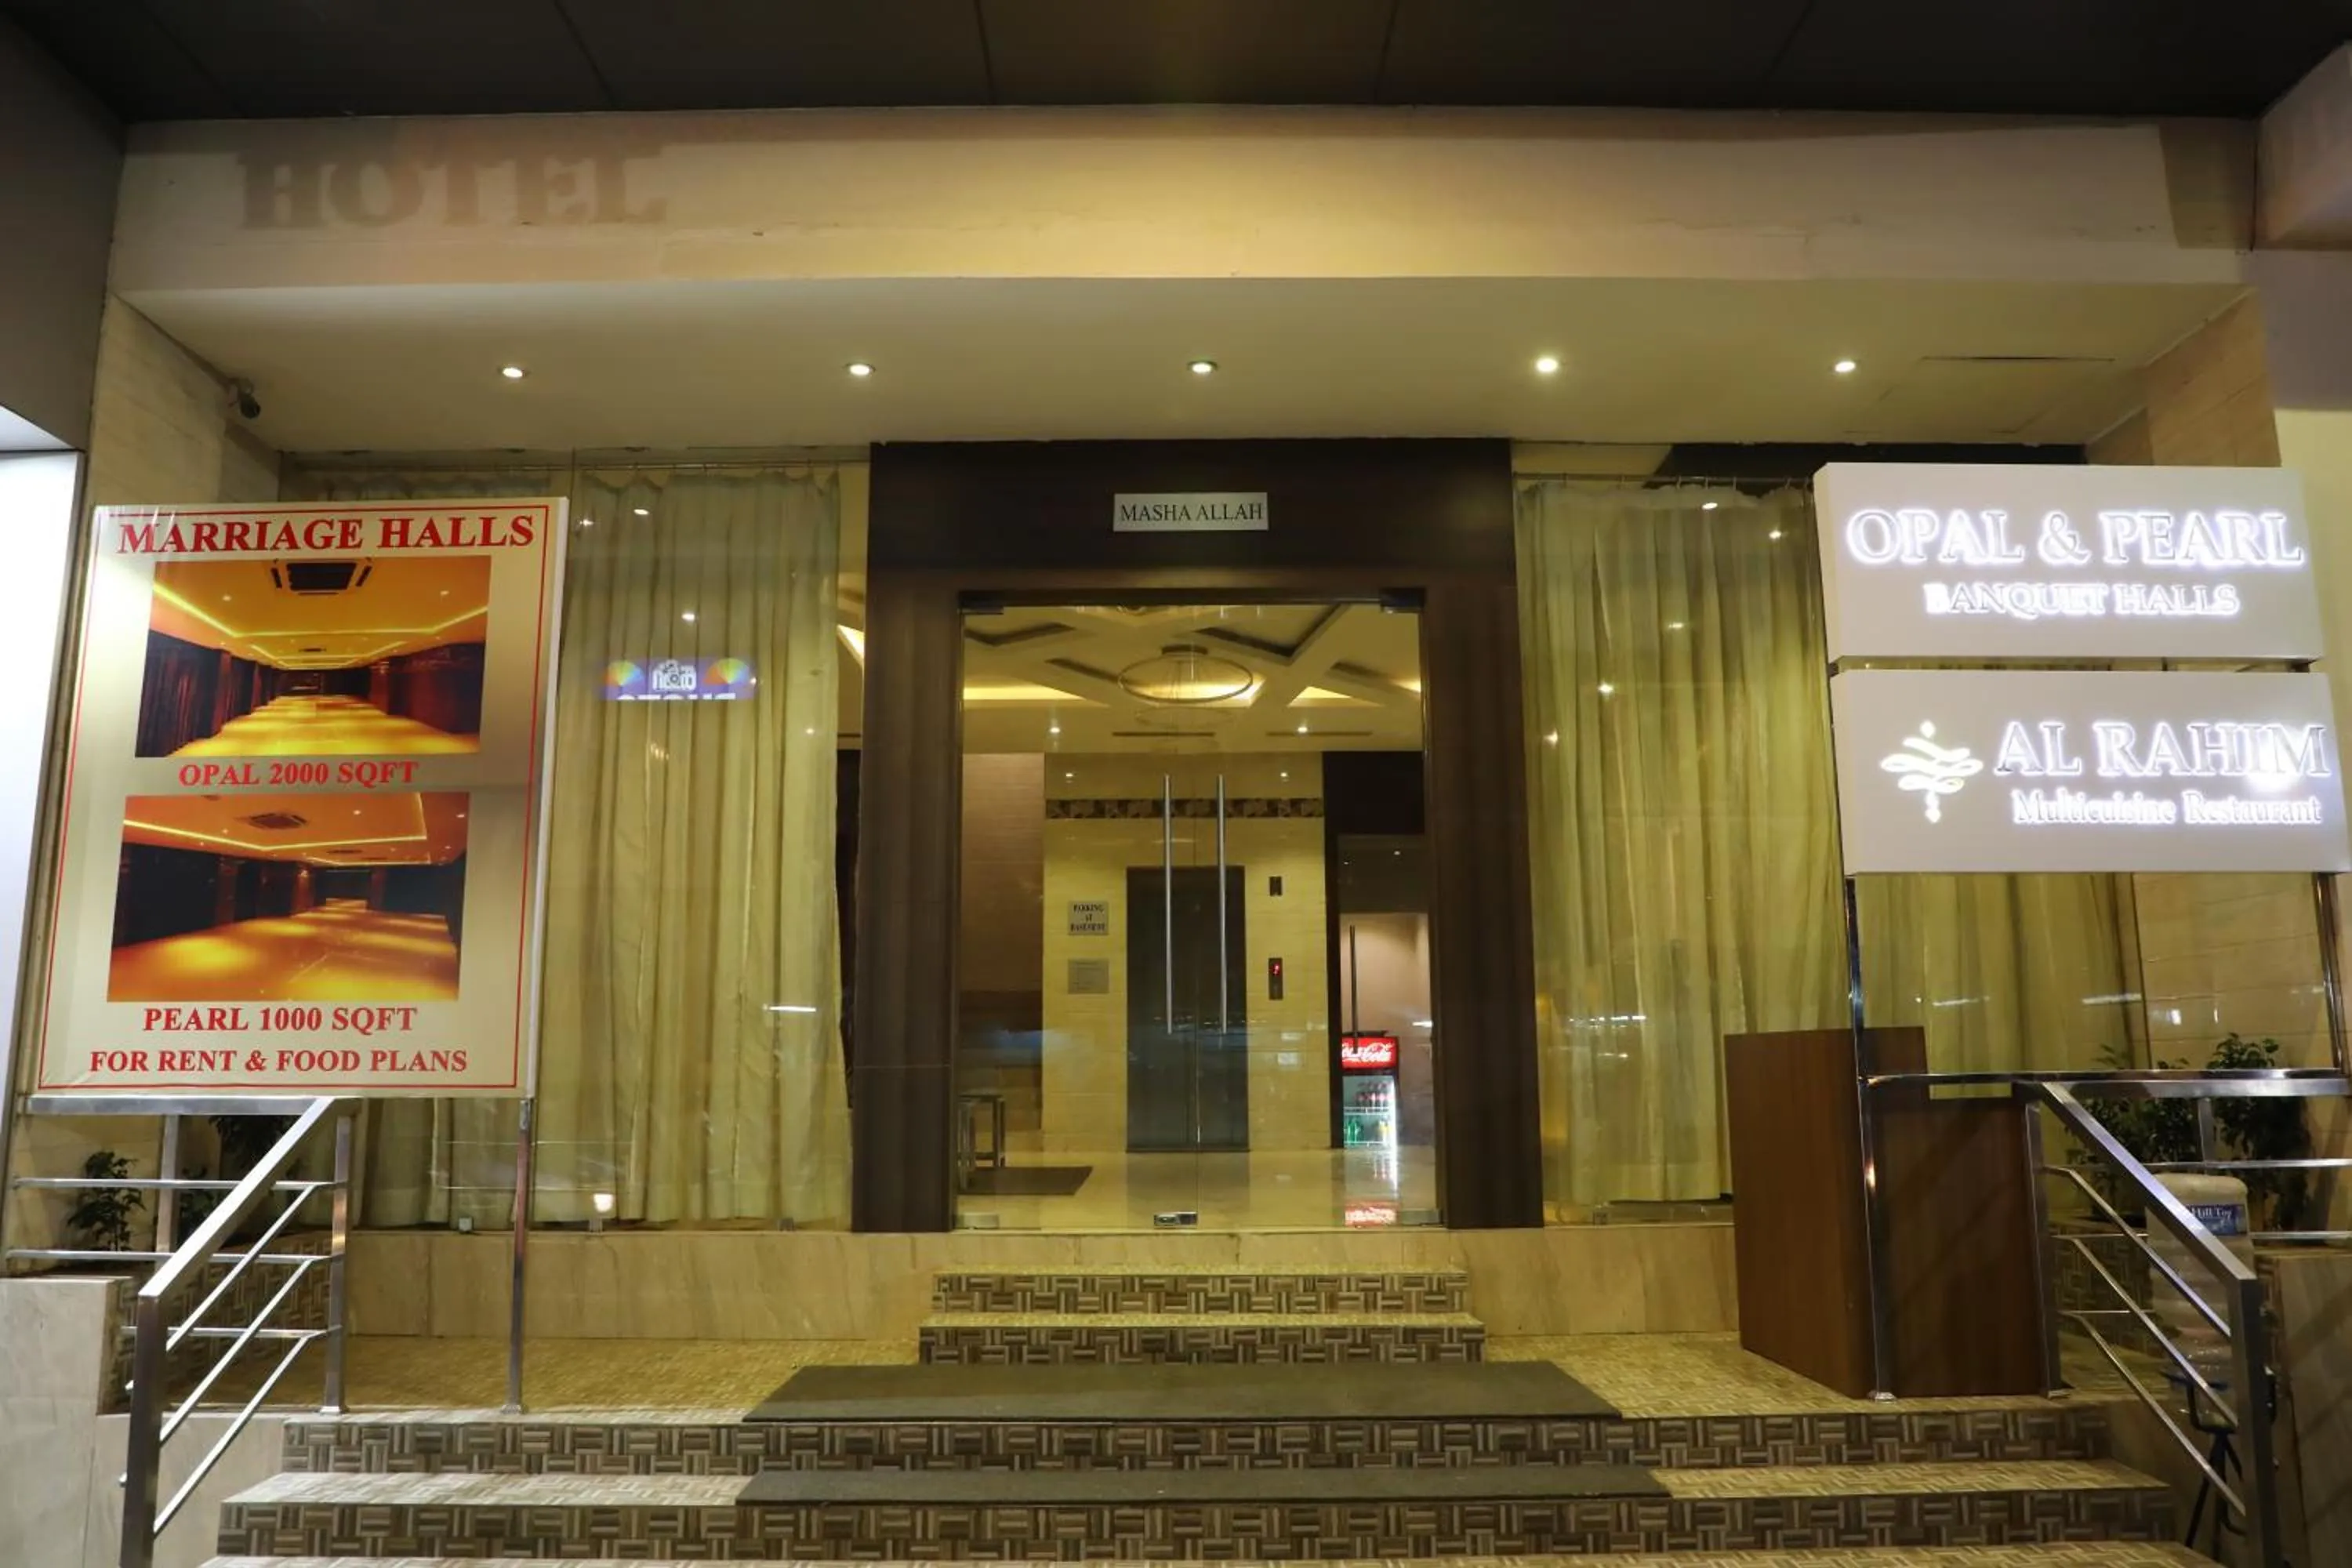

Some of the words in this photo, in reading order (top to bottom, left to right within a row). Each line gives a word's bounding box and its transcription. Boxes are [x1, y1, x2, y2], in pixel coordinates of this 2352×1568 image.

[238, 157, 666, 230] HOTEL
[1120, 504, 1191, 521] MASHA
[1196, 503, 1263, 521] ALLAH
[118, 518, 363, 554] MARRIAGE
[377, 515, 534, 549] HALLS
[1847, 508, 2025, 564] OPAL
[2038, 511, 2091, 564] &
[2100, 514, 2303, 566] PEARL
[1925, 583, 2108, 618] BANQUET
[2115, 585, 2240, 615] HALLS
[1994, 721, 2082, 776] AL
[2093, 723, 2331, 777] RAHIM
[178, 764, 260, 787] OPAL
[270, 762, 329, 786] 2000
[338, 760, 419, 787] SQFT
[2013, 790, 2175, 823] Multicuisine
[2183, 792, 2321, 824] Restaurant
[143, 1007, 249, 1032] PEARL
[261, 1007, 322, 1030] 1000
[332, 1007, 418, 1034] SQFT
[90, 1051, 148, 1072] FOR
[158, 1051, 238, 1072] RENT
[245, 1051, 267, 1072] &
[278, 1050, 360, 1072] FOOD
[370, 1050, 468, 1073] PLANS
